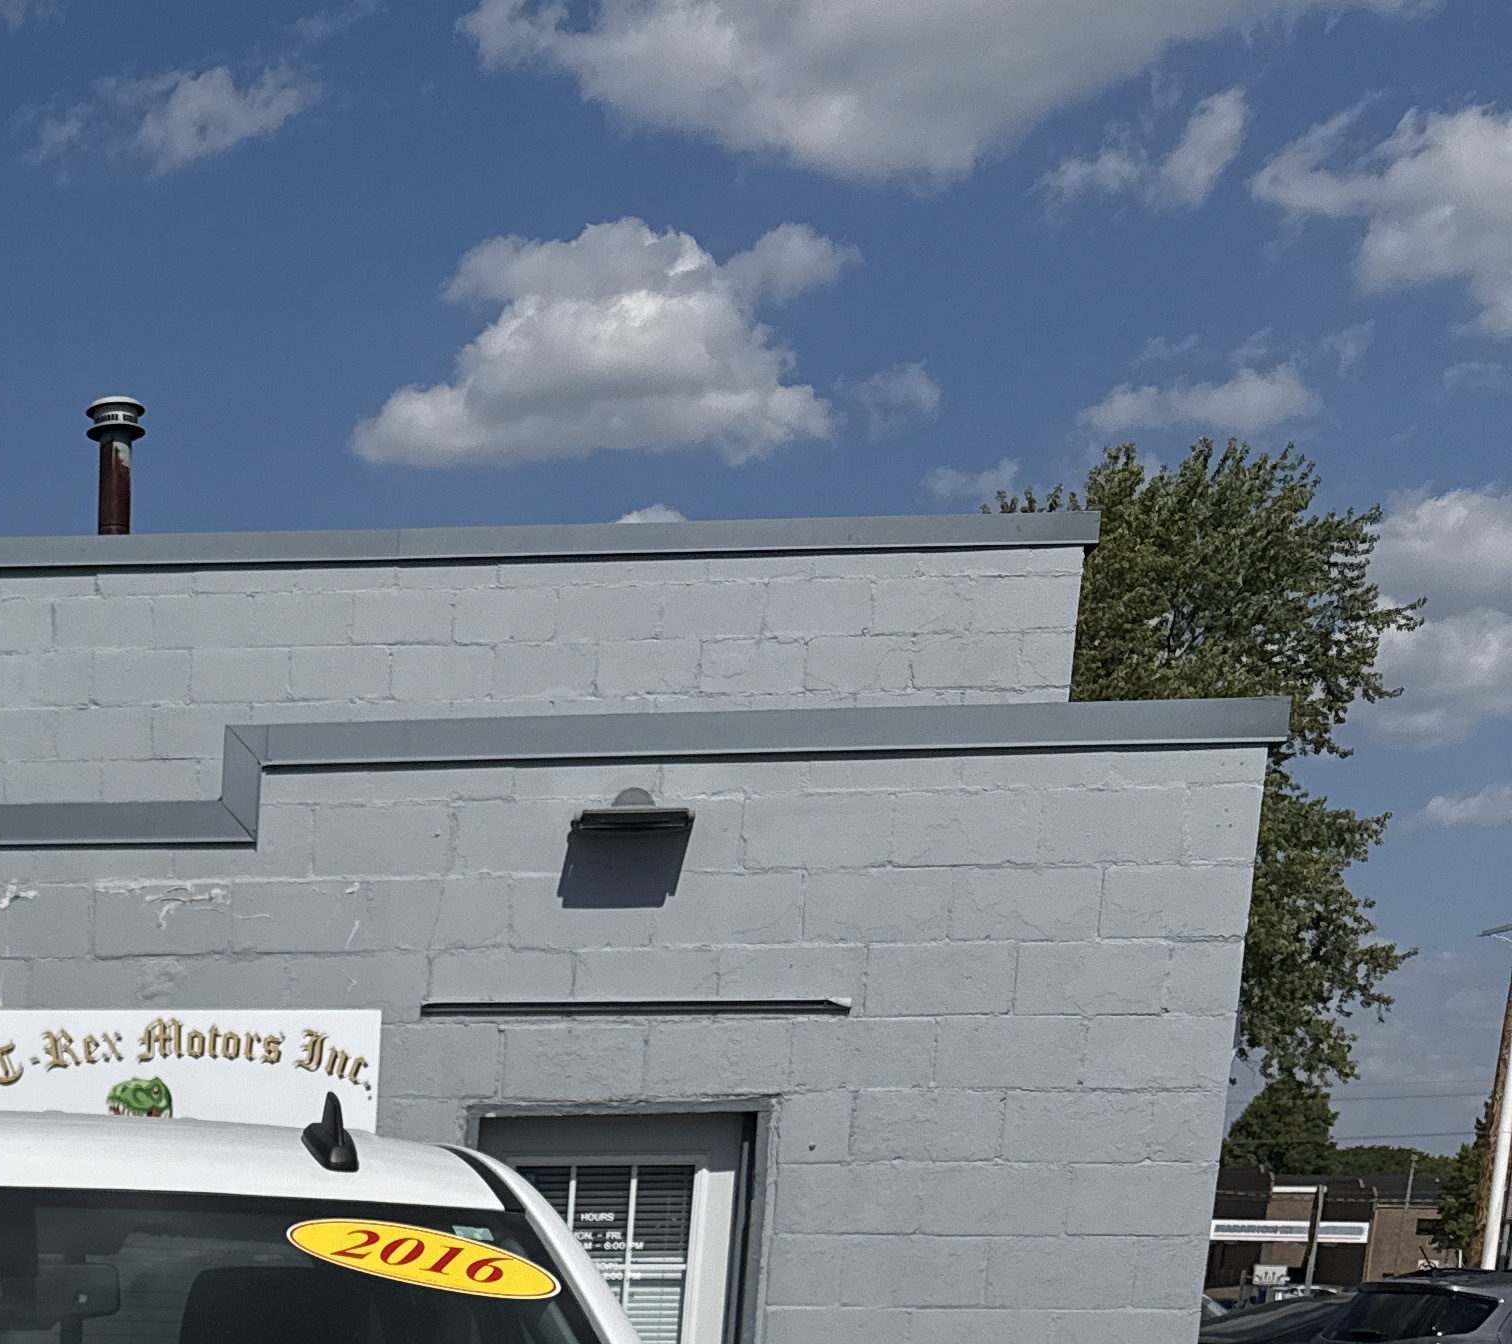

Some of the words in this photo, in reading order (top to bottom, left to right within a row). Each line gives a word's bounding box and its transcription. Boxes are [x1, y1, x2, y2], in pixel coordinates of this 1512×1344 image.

[138, 1017, 287, 1064] Motors
[580, 1212, 615, 1221] HOURS
[330, 1229, 514, 1283] 2016
